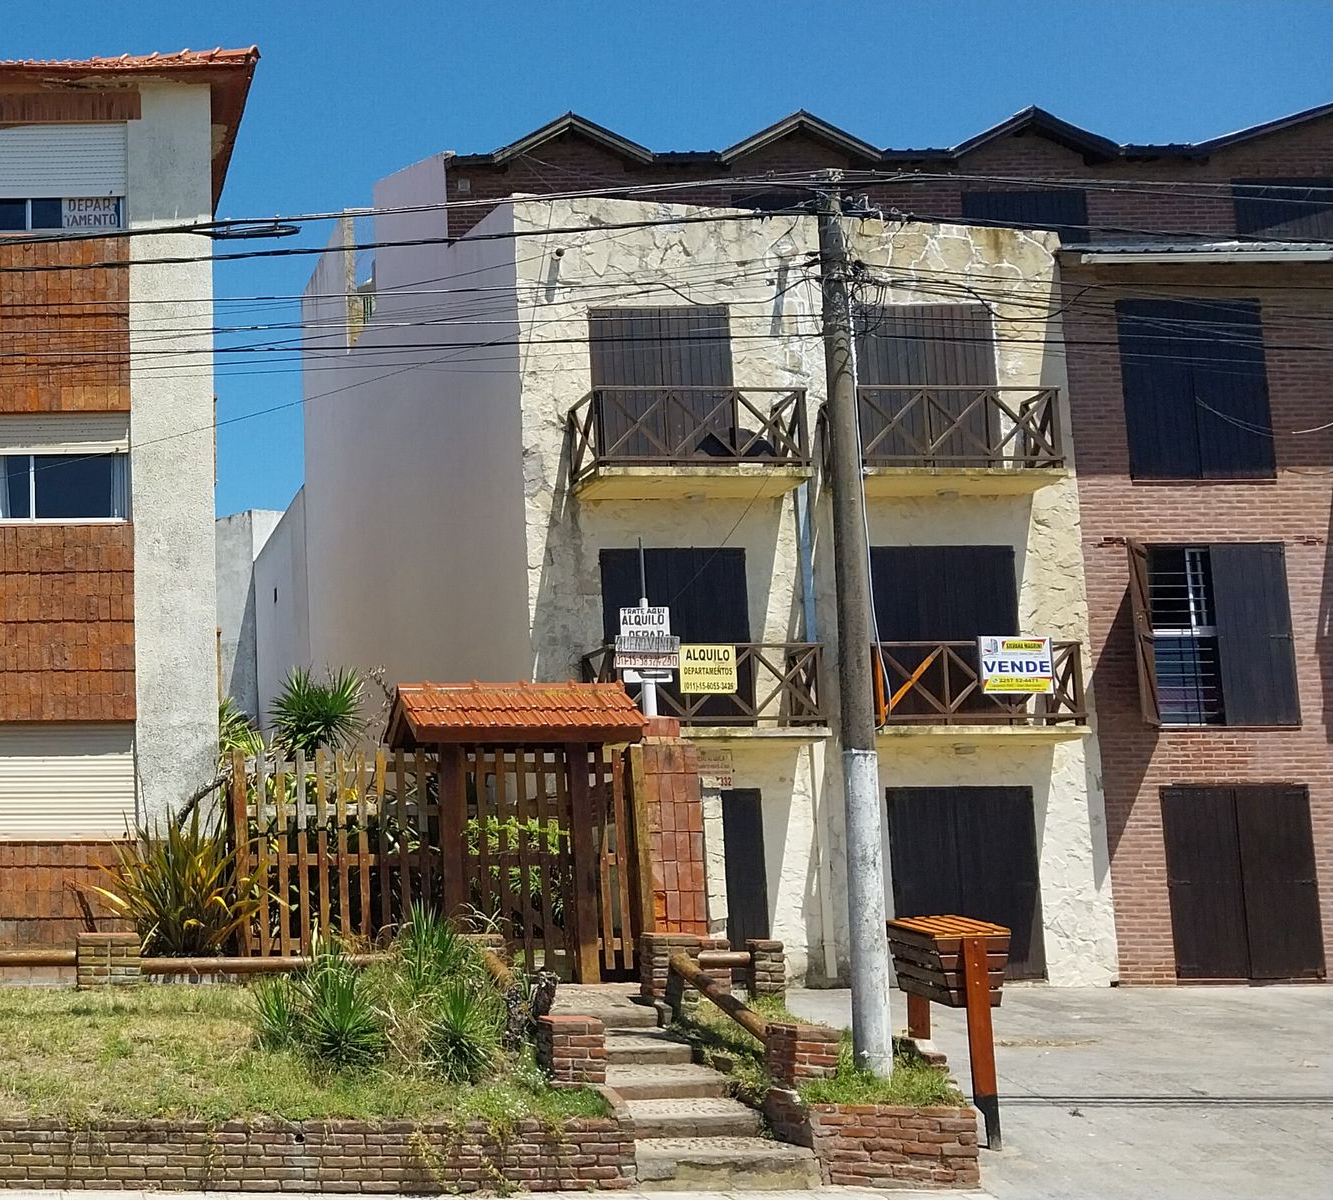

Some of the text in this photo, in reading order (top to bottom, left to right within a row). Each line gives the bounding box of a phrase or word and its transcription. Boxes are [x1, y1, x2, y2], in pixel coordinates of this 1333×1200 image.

[622, 614, 665, 626] ALQUILO
[686, 649, 730, 661] ALQUILO
[684, 667, 733, 675] DEPARTAMENTOS
[984, 660, 1051, 673] VENDE
